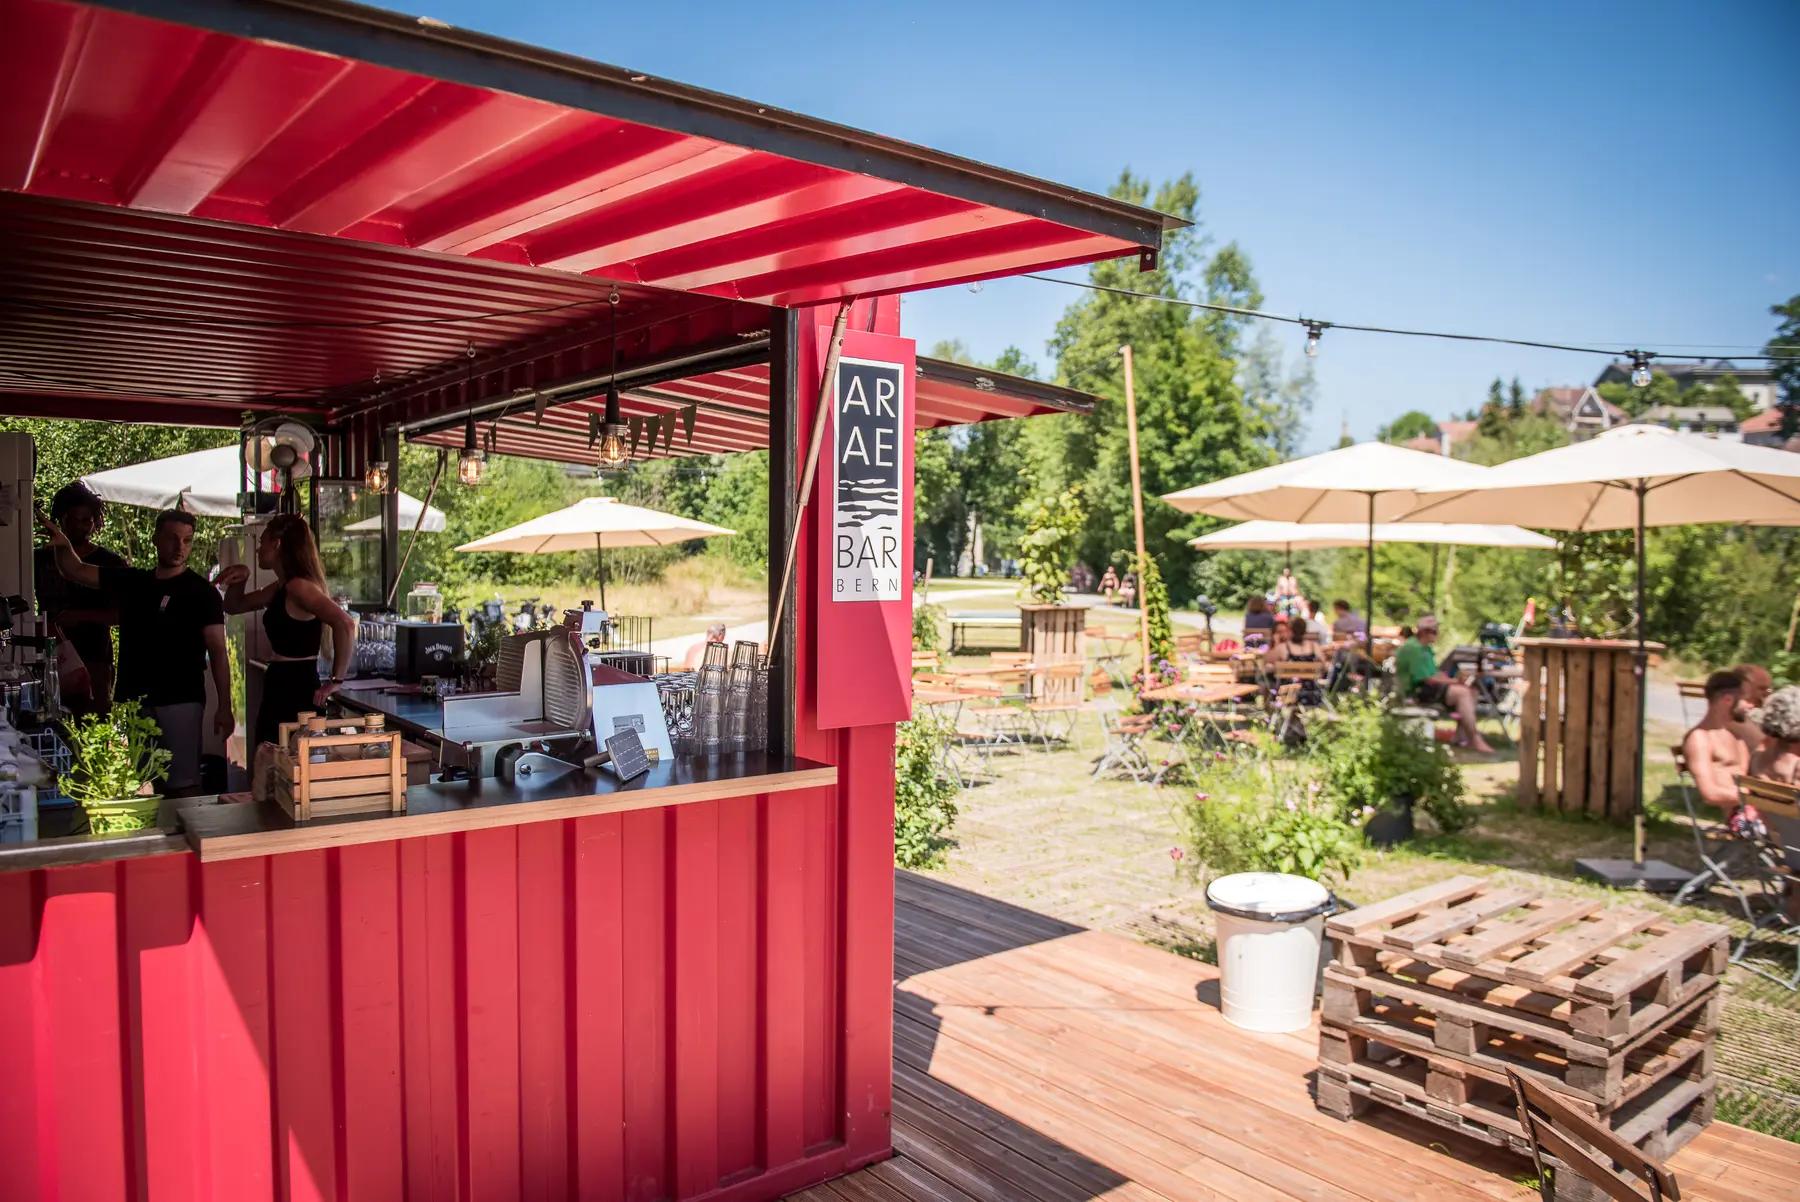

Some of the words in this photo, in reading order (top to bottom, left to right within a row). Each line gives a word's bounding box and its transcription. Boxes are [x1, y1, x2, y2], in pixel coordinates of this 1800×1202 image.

[842, 375, 897, 418] AR
[841, 425, 894, 467] AE
[837, 535, 898, 569] BAR
[836, 578, 898, 593] BERN
